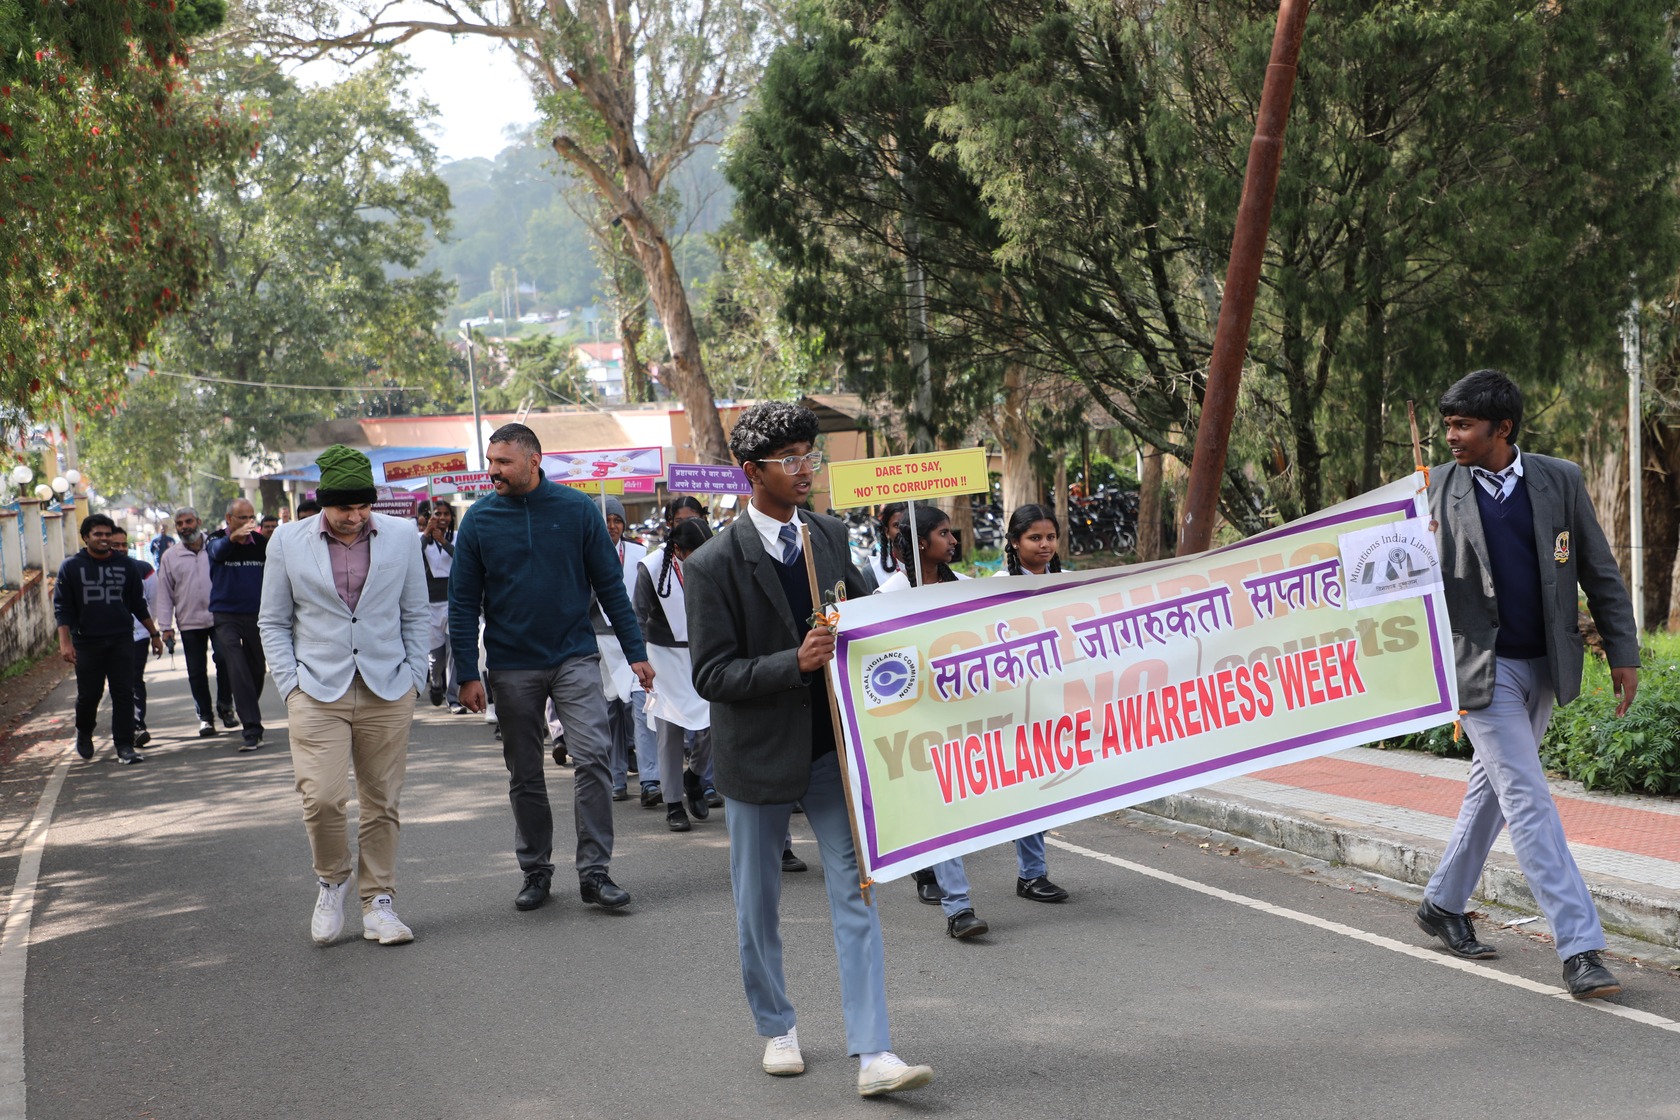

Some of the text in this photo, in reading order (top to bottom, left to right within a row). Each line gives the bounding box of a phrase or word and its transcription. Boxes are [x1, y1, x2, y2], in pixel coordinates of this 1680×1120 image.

[875, 460, 942, 477] DARE TO SAY,
[479, 483, 494, 491] NO
[876, 485, 890, 495] TO
[893, 477, 958, 494] CORRUPTION
[960, 476, 967, 486] !!
[1350, 533, 1439, 583] Munitions India Limited
[80, 566, 126, 585] US
[83, 585, 123, 605] PA
[931, 622, 1062, 699] सतर्कता
[1243, 559, 1341, 618] सप्ताह
[864, 652, 916, 704] CENTRAL VIGILANCE COMMISSION
[931, 640, 1365, 804] VIGILANCE AWARENESS WEEK
